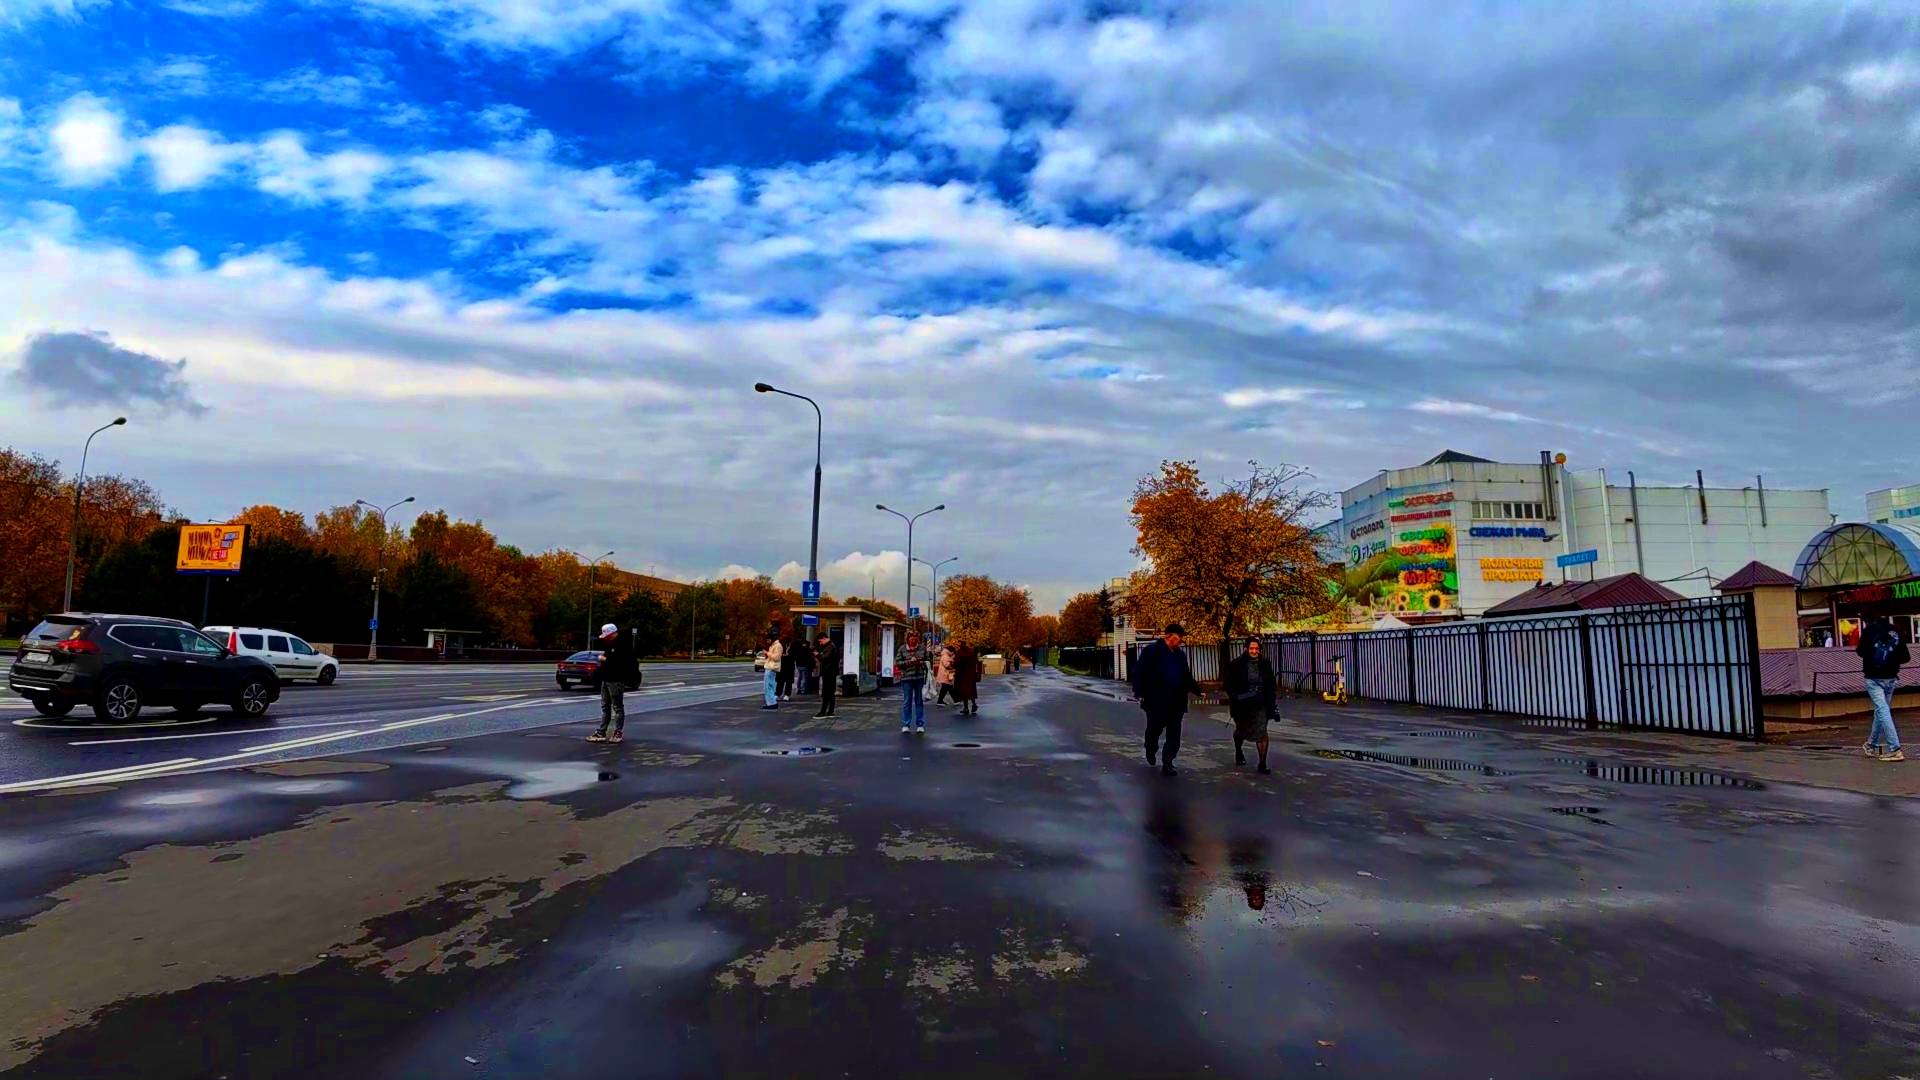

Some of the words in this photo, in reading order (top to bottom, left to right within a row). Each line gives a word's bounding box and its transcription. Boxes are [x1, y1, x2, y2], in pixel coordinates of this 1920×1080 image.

[1469, 527, 1513, 538] СВЕЖАЯ
[1515, 527, 1546, 538] РЫБА
[1480, 558, 1544, 570] МОЛОЧНЫЕ
[1483, 571, 1543, 583] ПРОДУКТЫ
